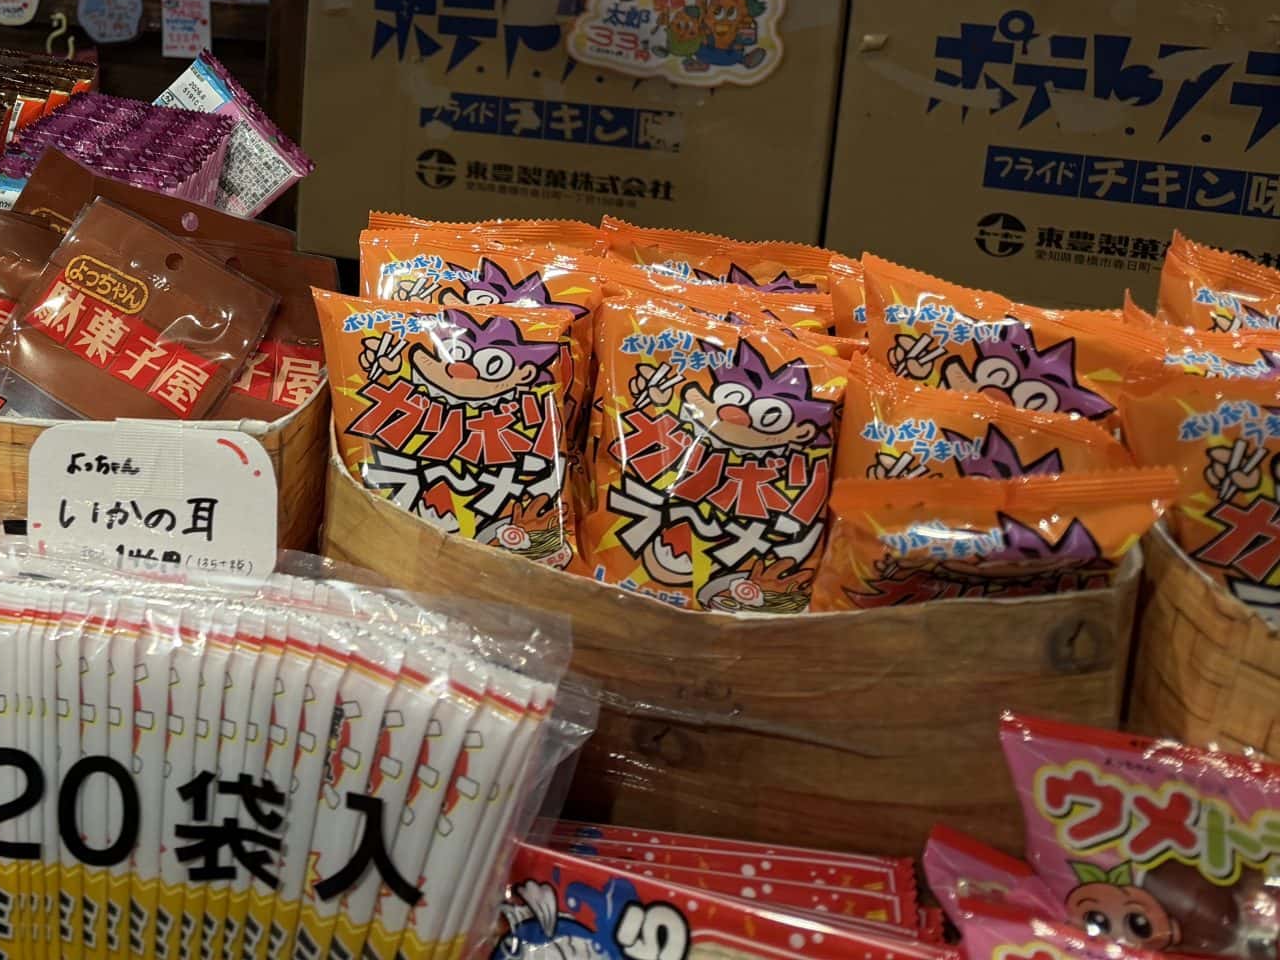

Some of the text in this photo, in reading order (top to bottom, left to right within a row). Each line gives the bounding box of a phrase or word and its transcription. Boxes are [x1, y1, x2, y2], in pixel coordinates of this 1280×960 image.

[603, 3, 650, 29] 太郎
[465, 159, 677, 202] 東豊製菓株式会社
[68, 260, 147, 310] よっちゃん
[883, 303, 957, 326] ボリボリ
[620, 328, 694, 355] ボリボリ
[931, 322, 1003, 344] うまい!
[34, 281, 209, 414] 駄菓子屋
[671, 346, 735, 371] うまい!
[344, 380, 565, 465] ガリボリ
[861, 419, 937, 442] ボリボリ
[1178, 400, 1261, 442] ボリボリ
[66, 451, 141, 476] よっちゃん
[911, 438, 983, 463] うまい!
[612, 410, 830, 524] ガリボリ
[58, 497, 219, 542] いかの耳
